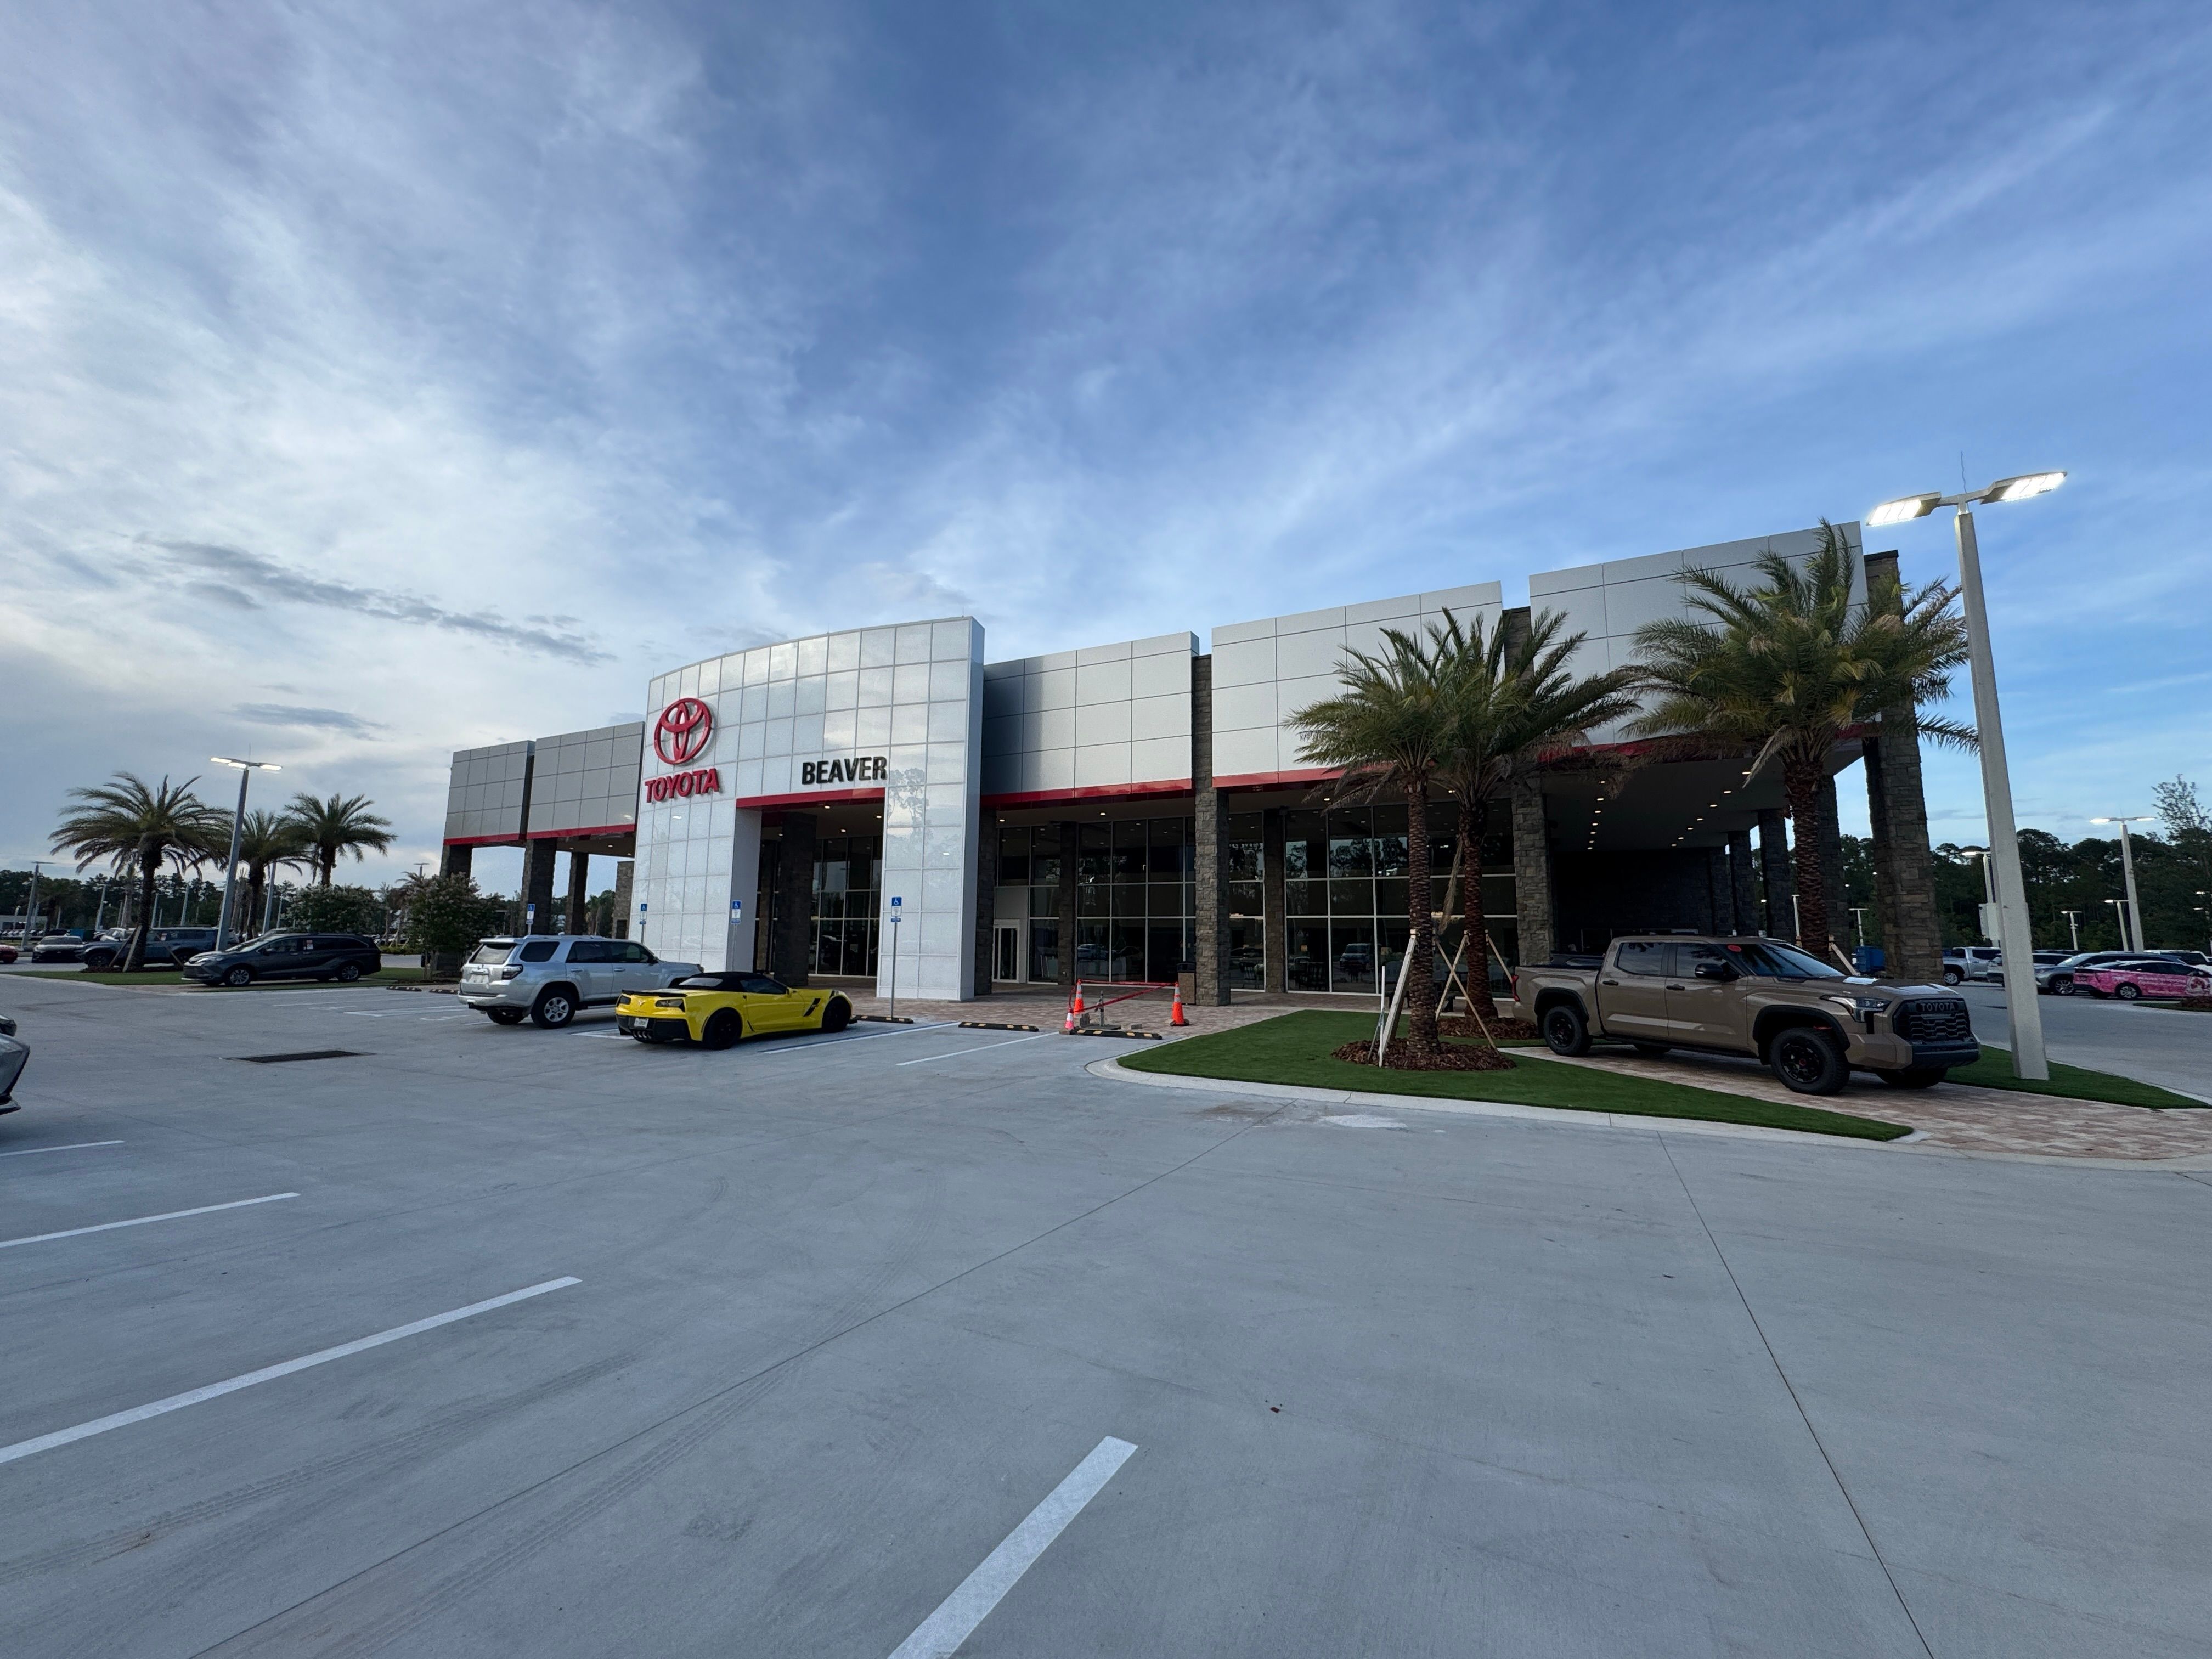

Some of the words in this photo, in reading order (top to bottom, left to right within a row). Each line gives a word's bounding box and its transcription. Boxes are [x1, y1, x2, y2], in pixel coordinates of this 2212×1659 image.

[802, 756, 887, 785] BEAVER
[645, 768, 719, 803] TOYOTA
[1920, 1002, 1955, 1012] TOYOTA
